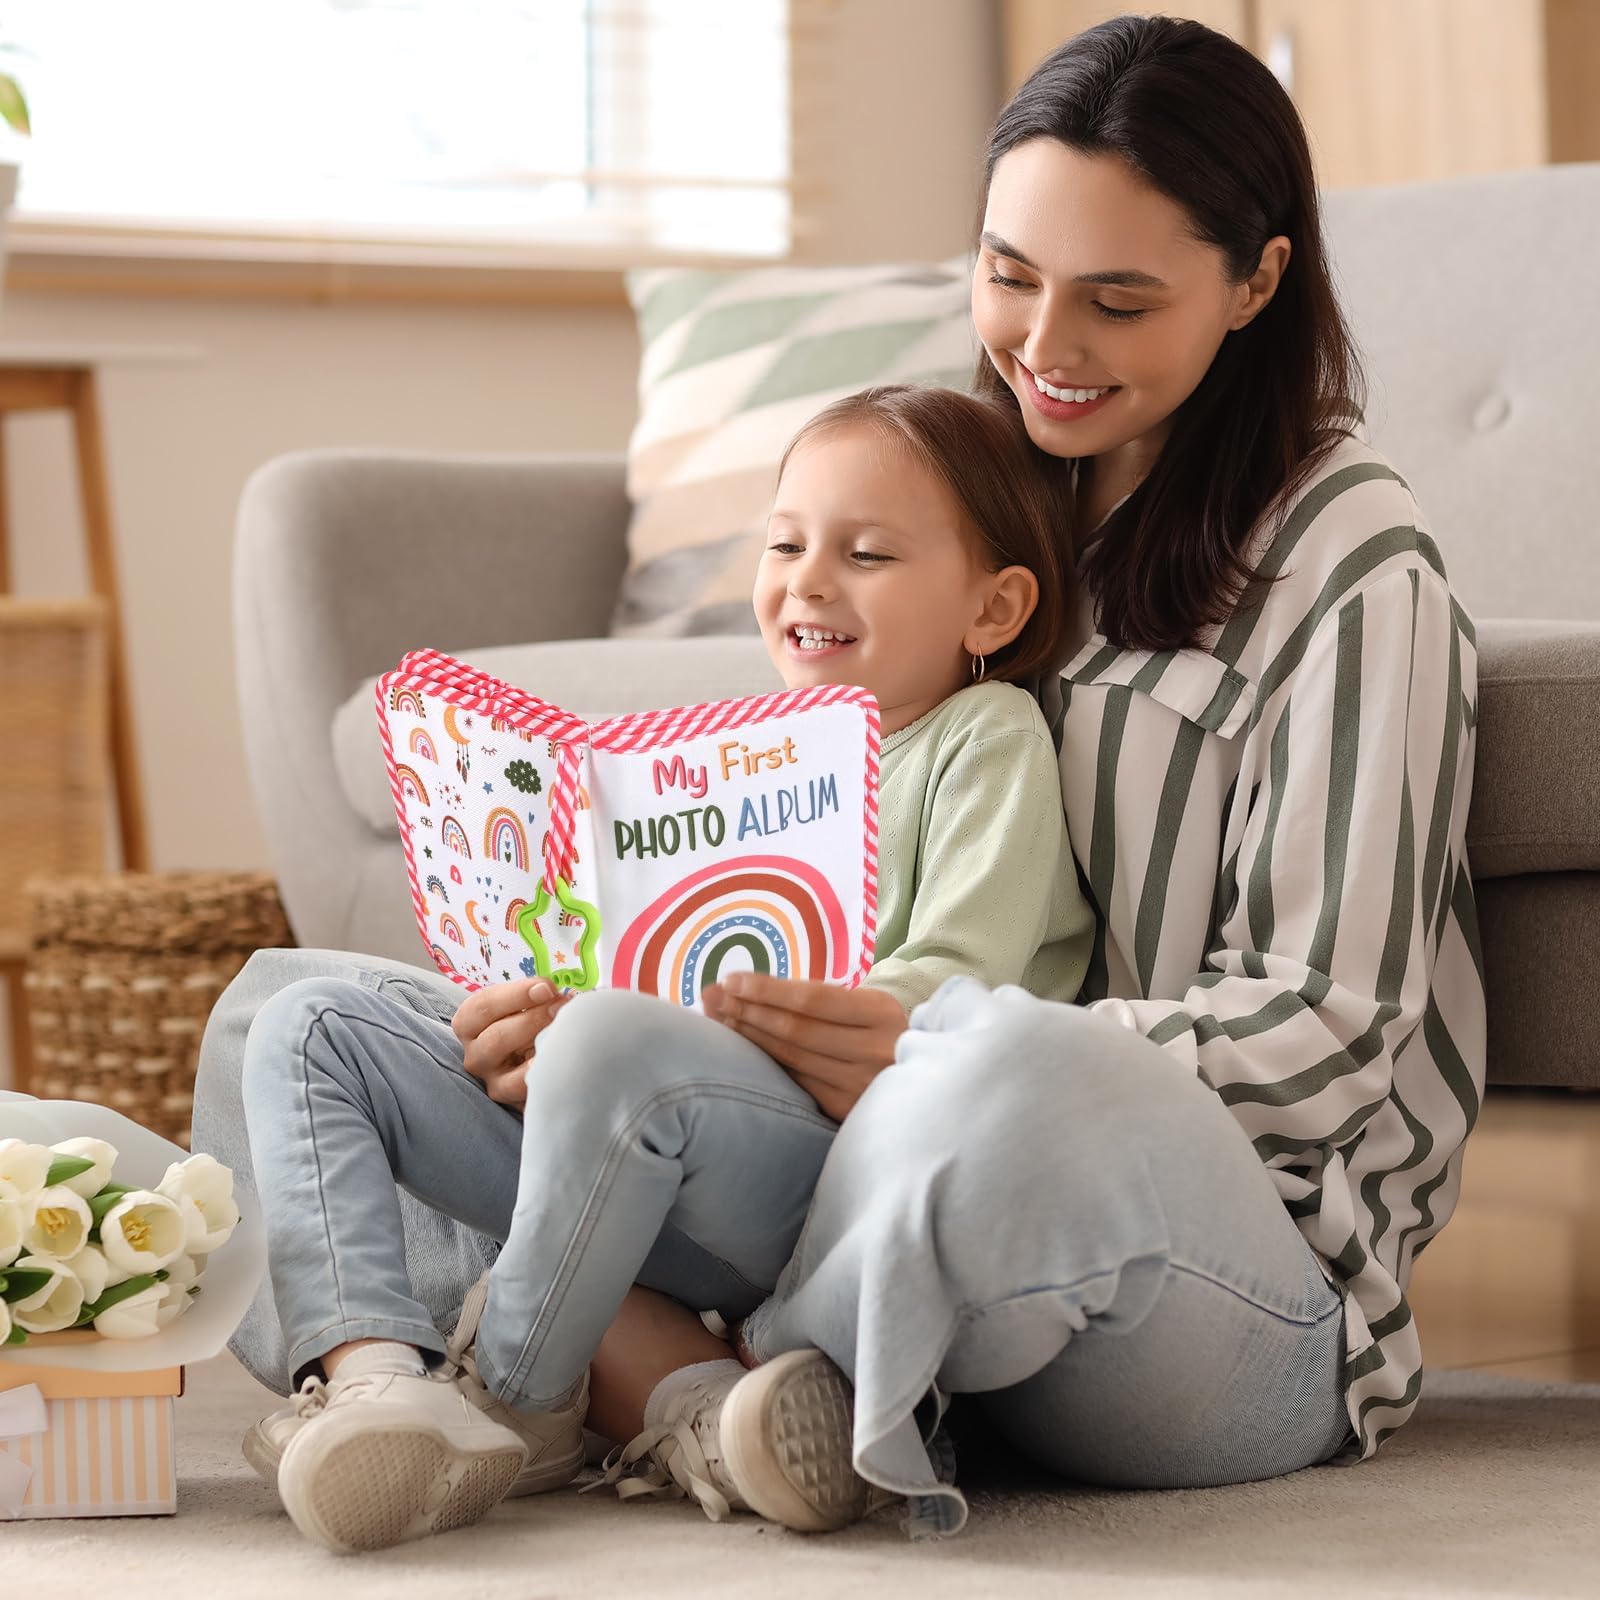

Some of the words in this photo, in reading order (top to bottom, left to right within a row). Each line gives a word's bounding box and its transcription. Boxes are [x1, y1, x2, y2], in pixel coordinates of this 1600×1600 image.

[652, 755, 708, 798] My
[718, 736, 798, 780] First
[614, 805, 725, 860] PHOTO
[737, 773, 839, 841] ALBUM
